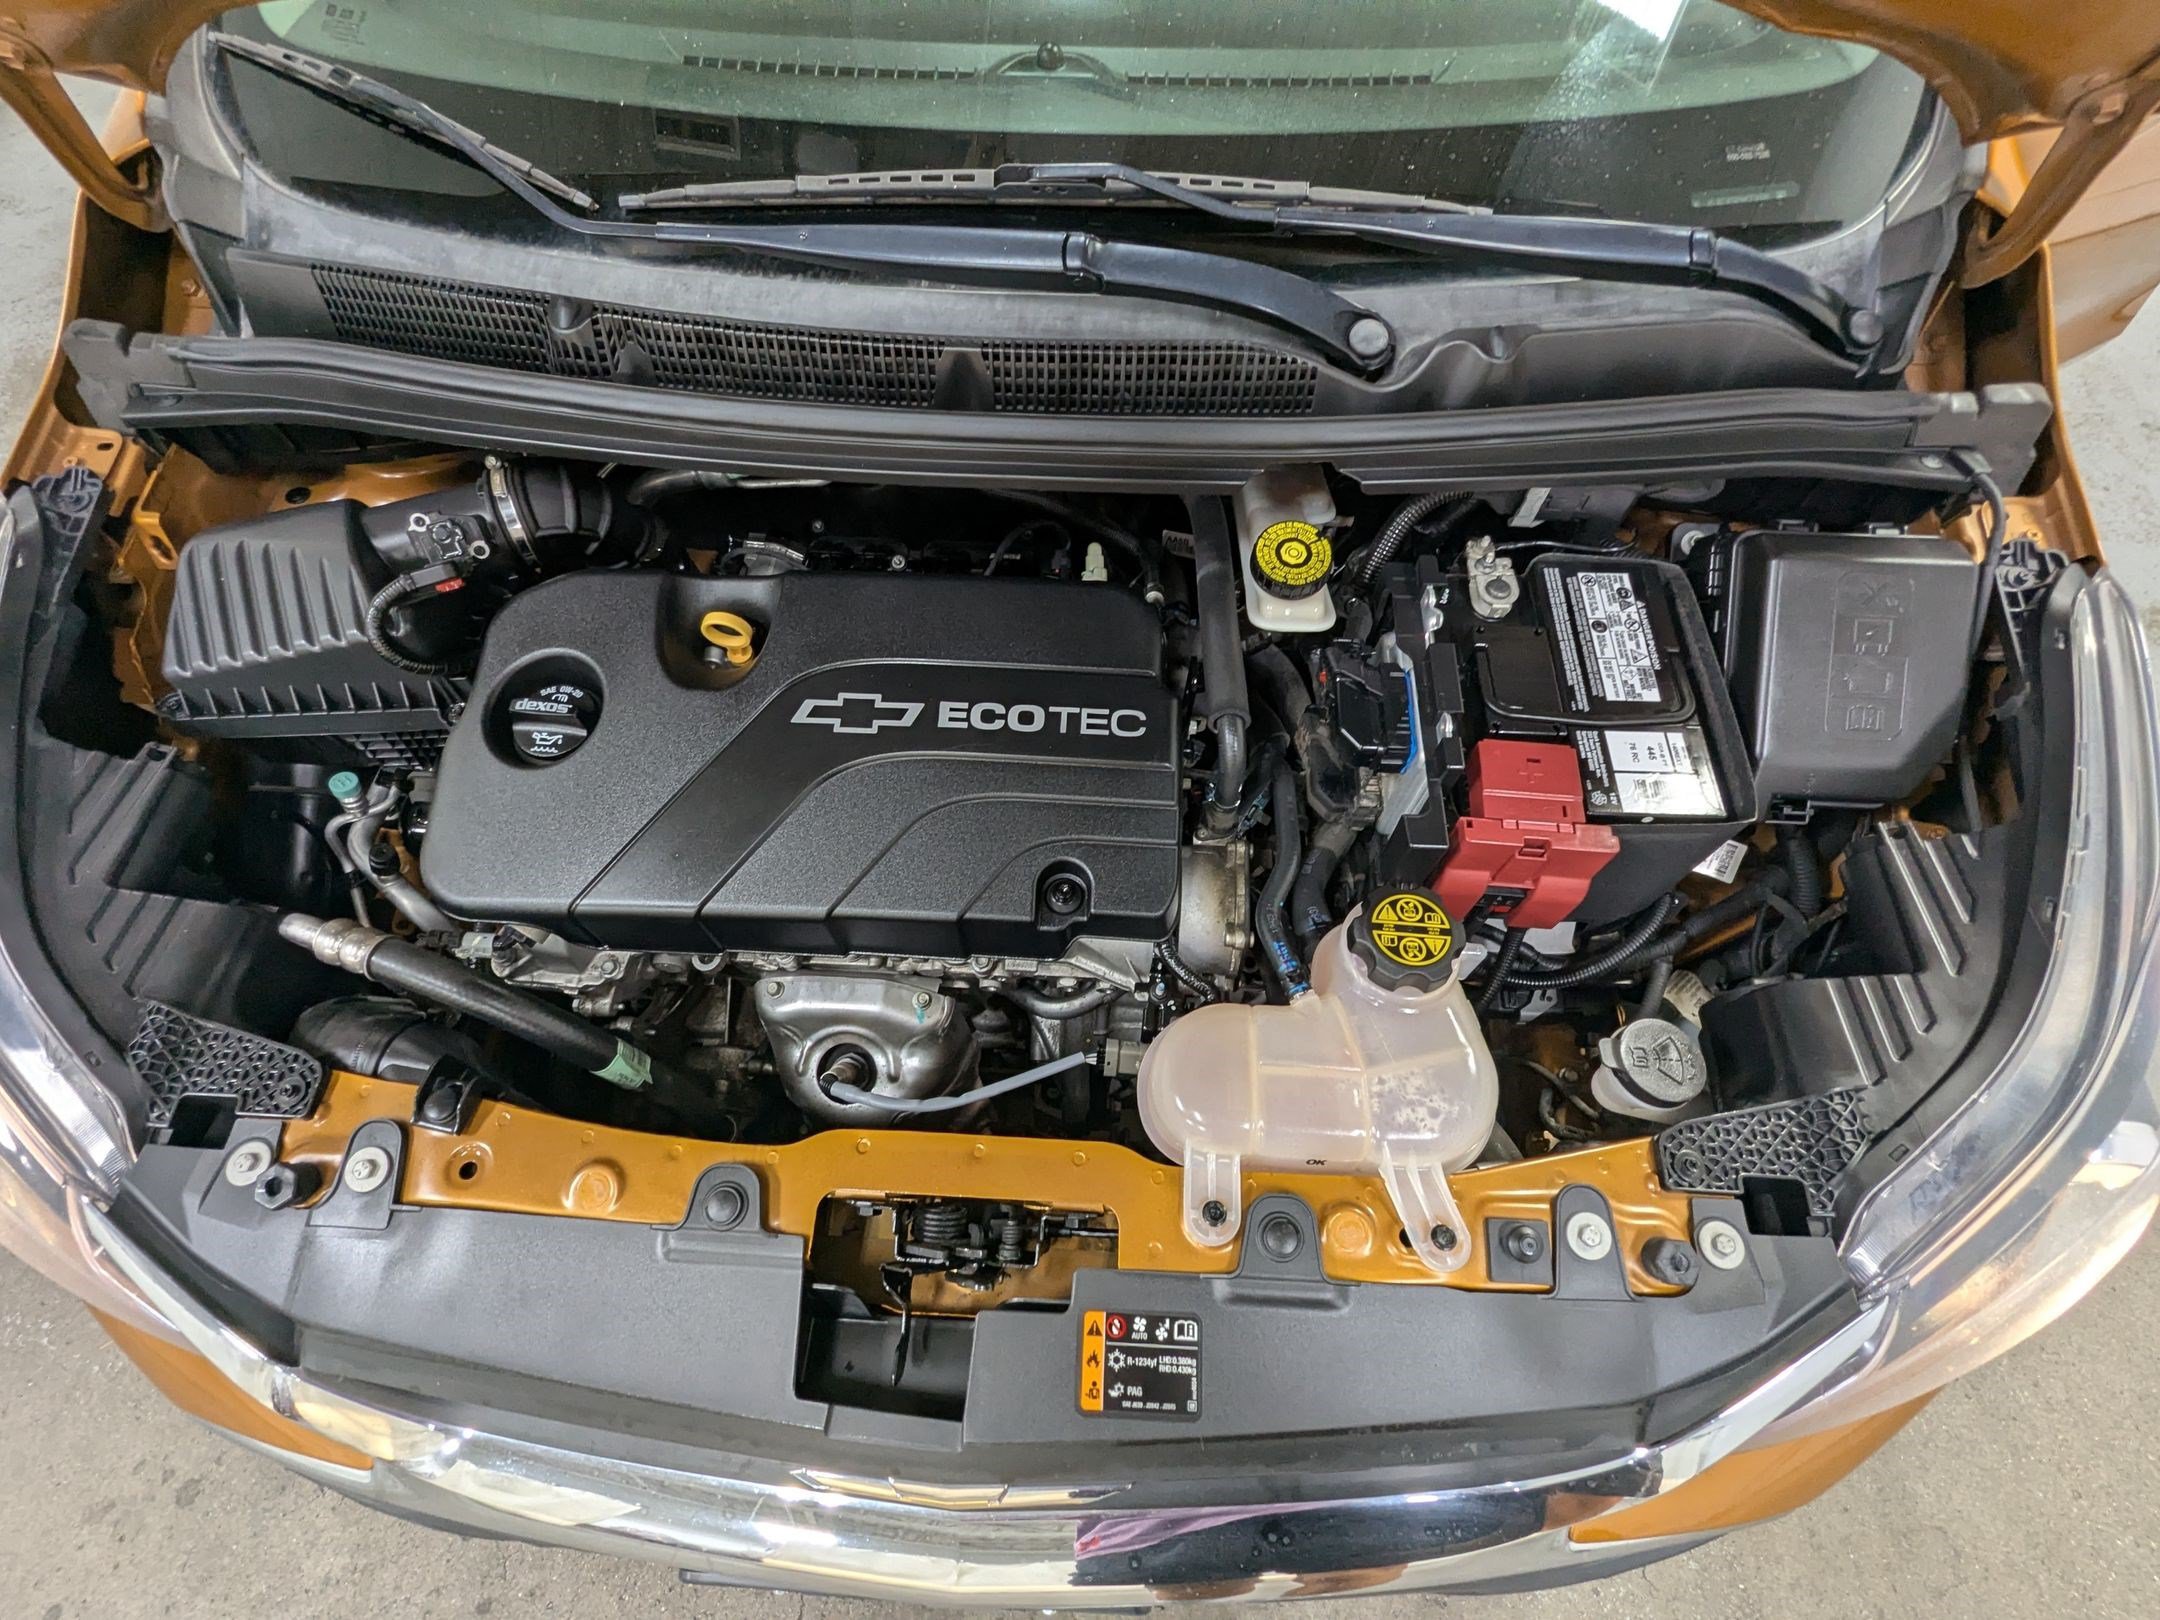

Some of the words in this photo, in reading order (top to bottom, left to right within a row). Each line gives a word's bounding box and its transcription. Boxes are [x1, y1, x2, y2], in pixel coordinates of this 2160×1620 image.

[540, 686, 557, 697] SAE
[514, 698, 573, 714] dexos
[937, 701, 1147, 738] ECOTEC
[1647, 746, 1657, 761] 445
[1131, 1331, 1148, 1340] AUTO
[1127, 1386, 1143, 1397] PAG
